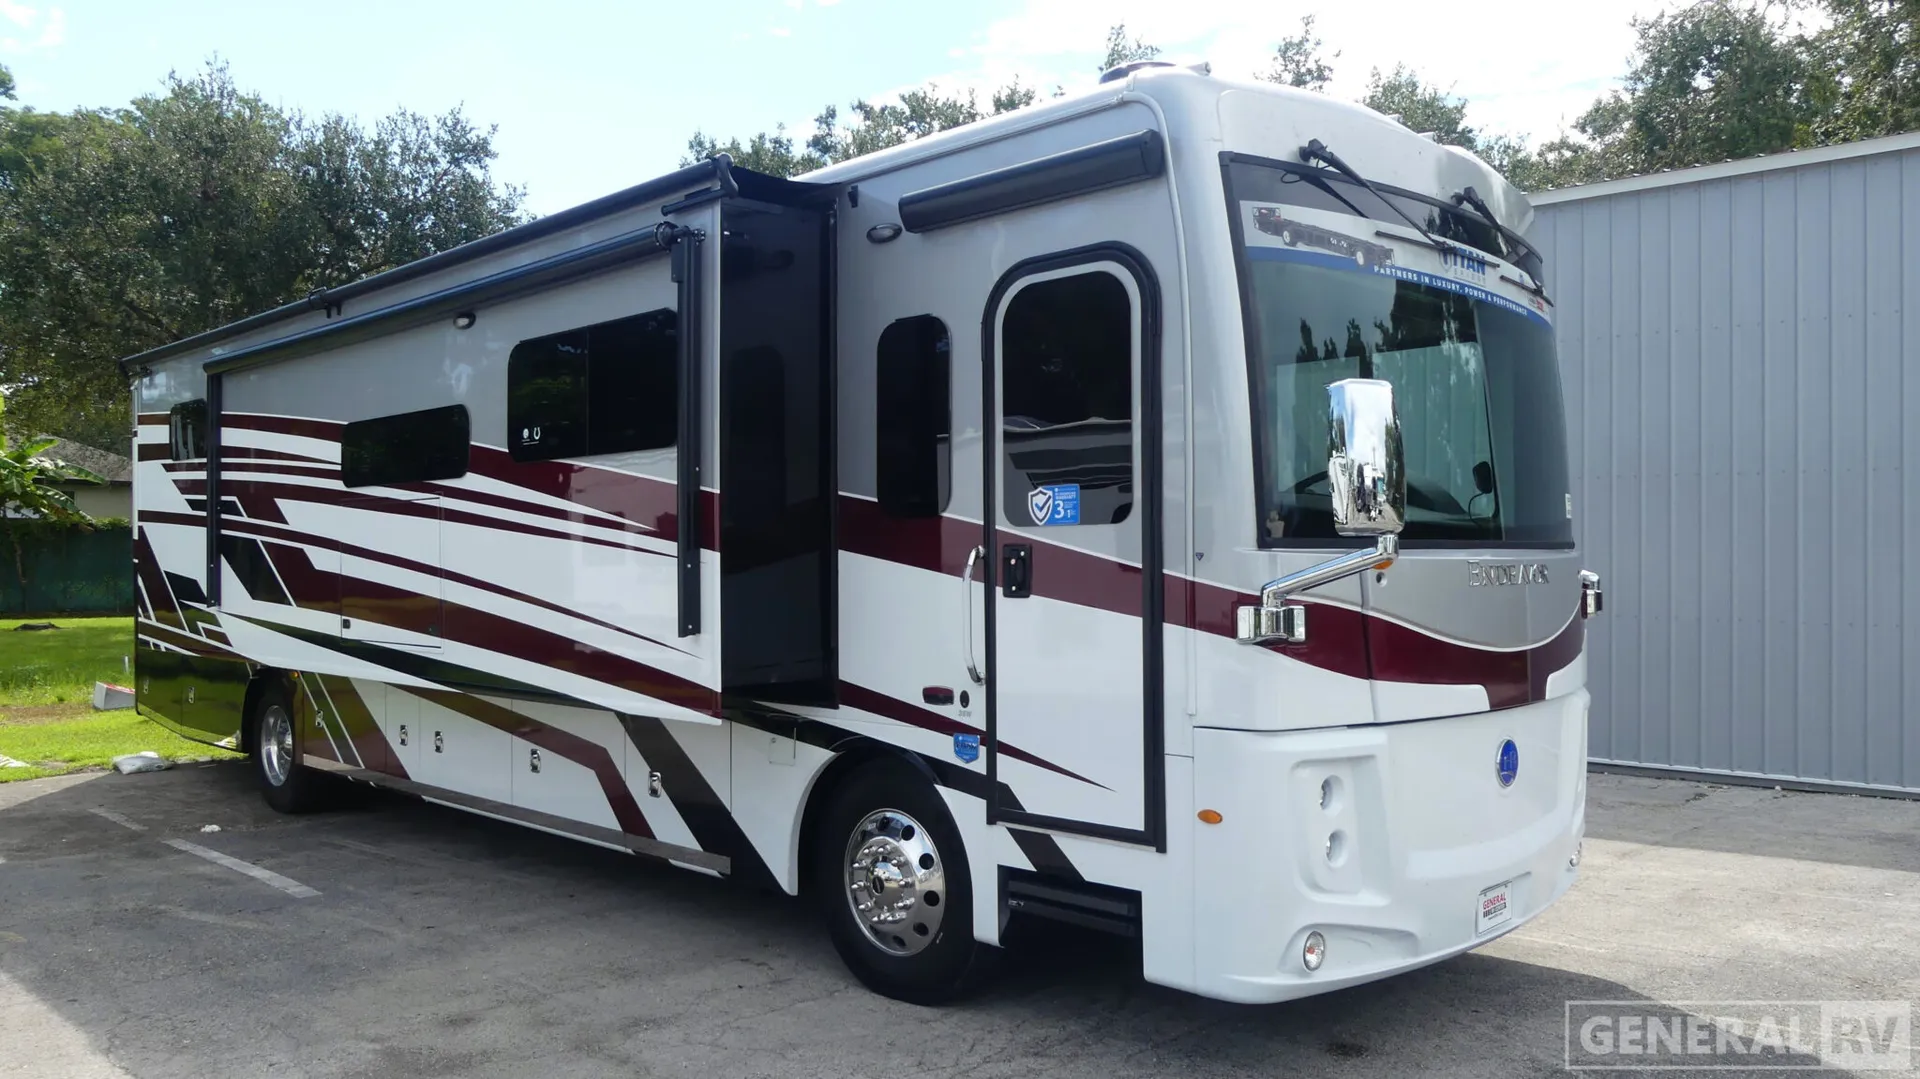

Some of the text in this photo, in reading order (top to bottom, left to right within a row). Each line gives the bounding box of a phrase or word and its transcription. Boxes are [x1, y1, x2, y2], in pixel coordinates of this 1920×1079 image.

[1374, 265, 1417, 280] PARTNERS
[1421, 274, 1429, 284] IN
[1432, 278, 1463, 293] LUXURY,
[1464, 286, 1485, 299] POWER
[1493, 296, 1527, 316] PERFORMANCE
[1482, 891, 1506, 910] GENERAL
